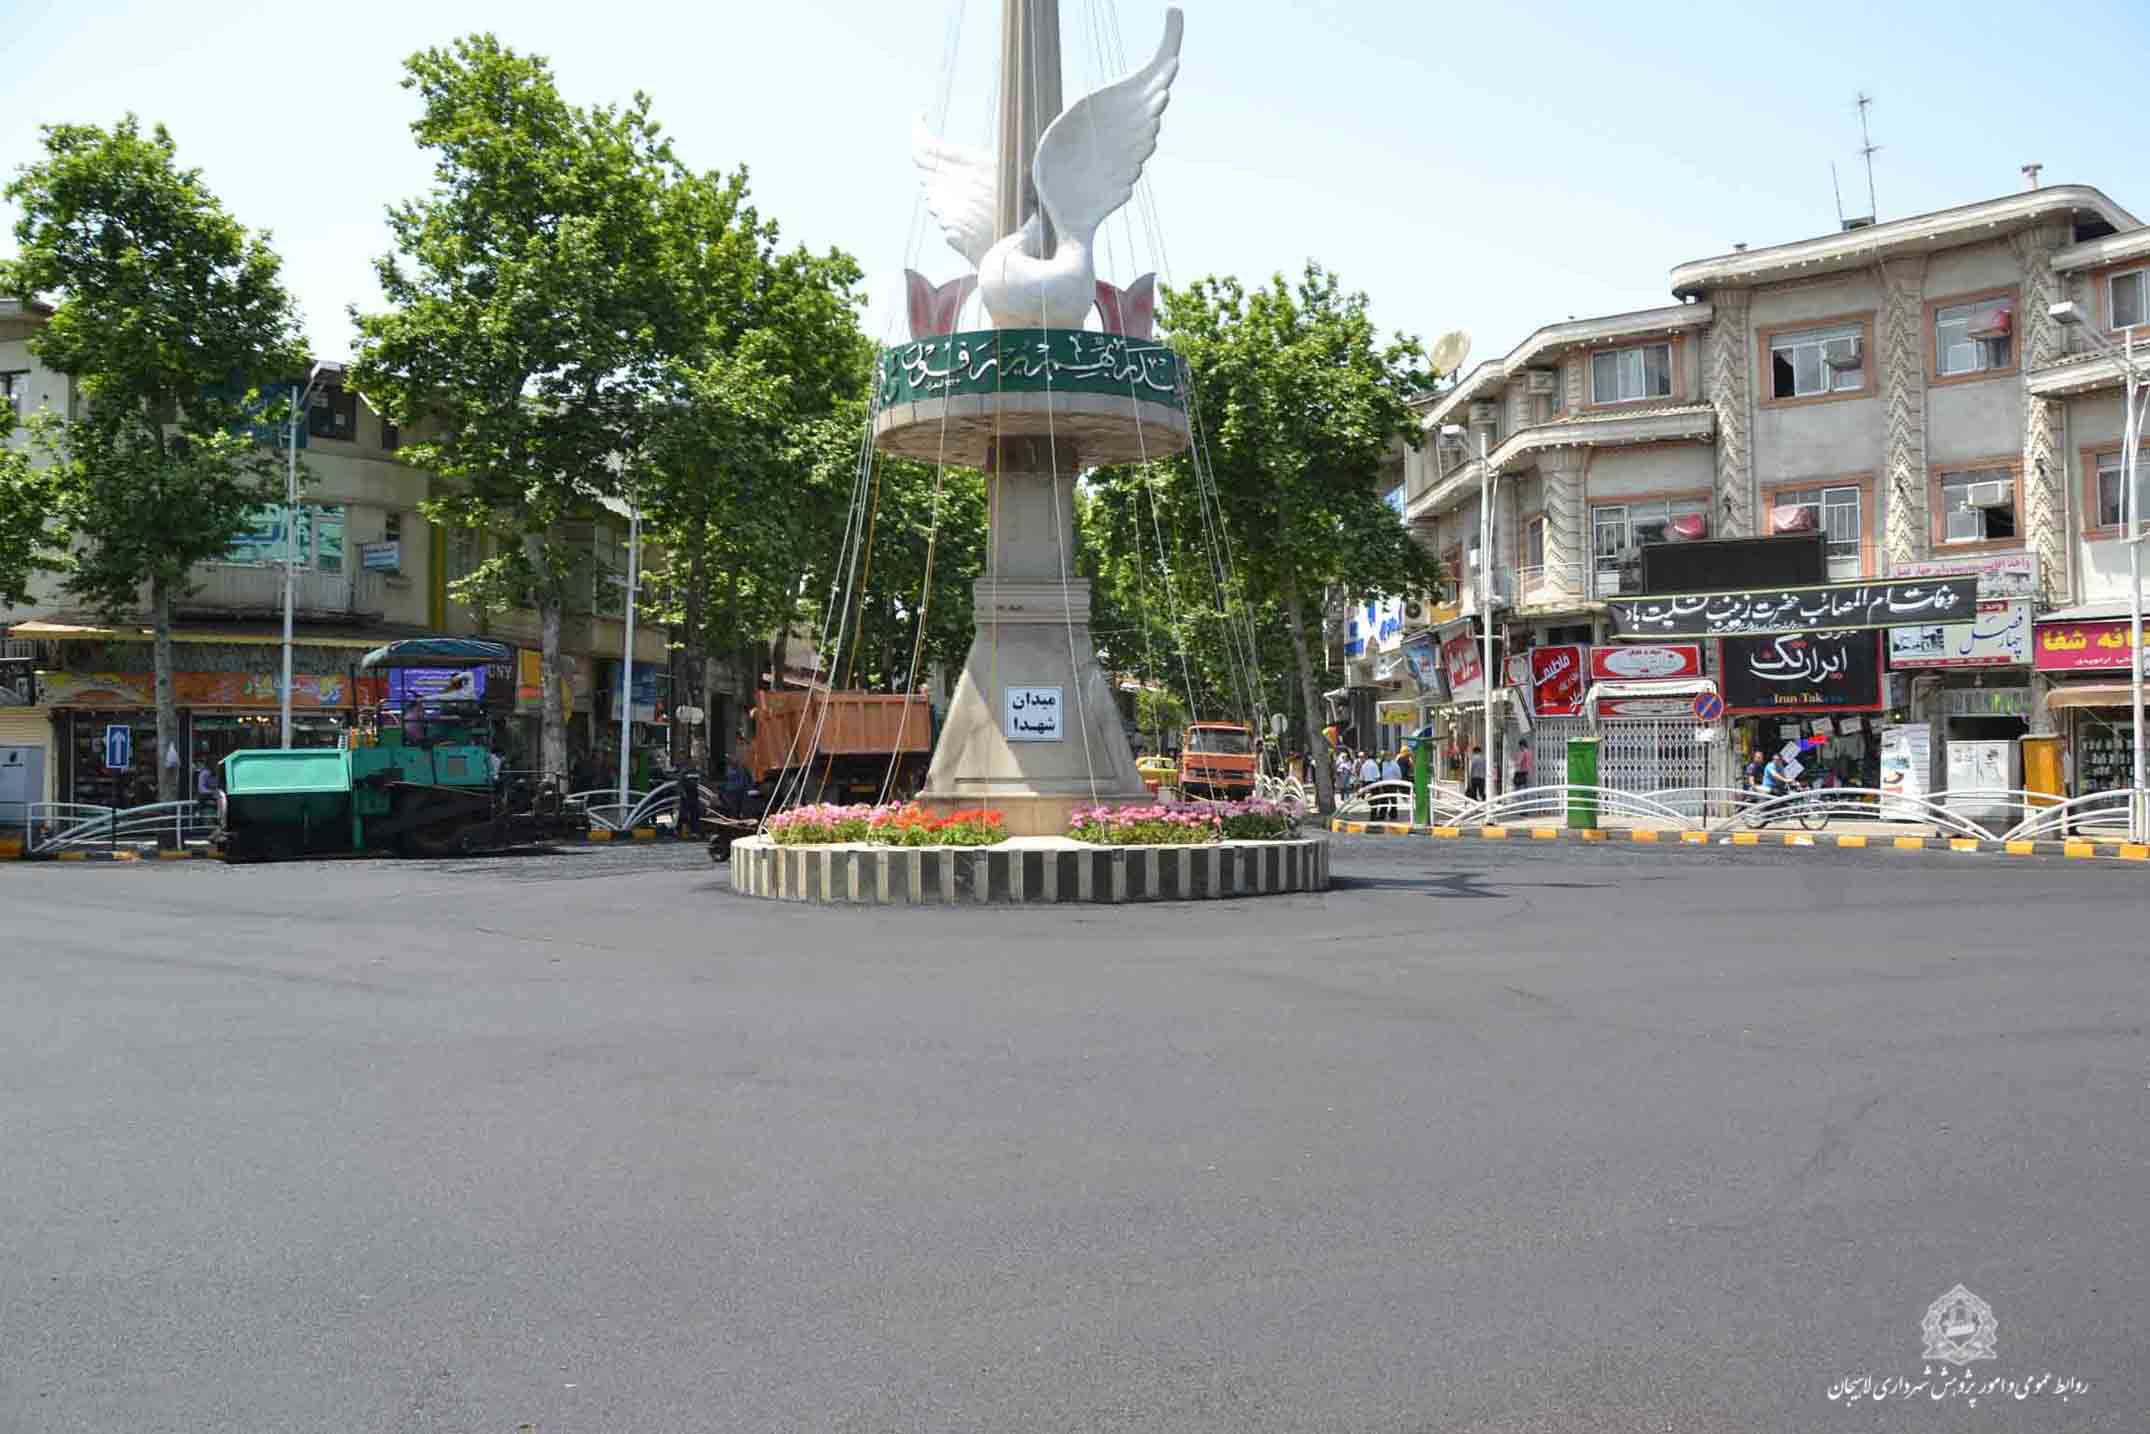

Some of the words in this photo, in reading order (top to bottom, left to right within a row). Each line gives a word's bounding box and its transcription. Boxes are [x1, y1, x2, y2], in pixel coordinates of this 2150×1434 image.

[1624, 601, 1640, 631] باد
[1641, 596, 1710, 627] تسلیت
[1705, 594, 1751, 627] زینب
[1751, 592, 1801, 624] حضرت
[1751, 632, 1807, 669] تک
[2043, 626, 2088, 651] شفا
[1749, 645, 1848, 683] ایران
[1012, 692, 1056, 710] میدان
[1013, 716, 1056, 735] شهدا
